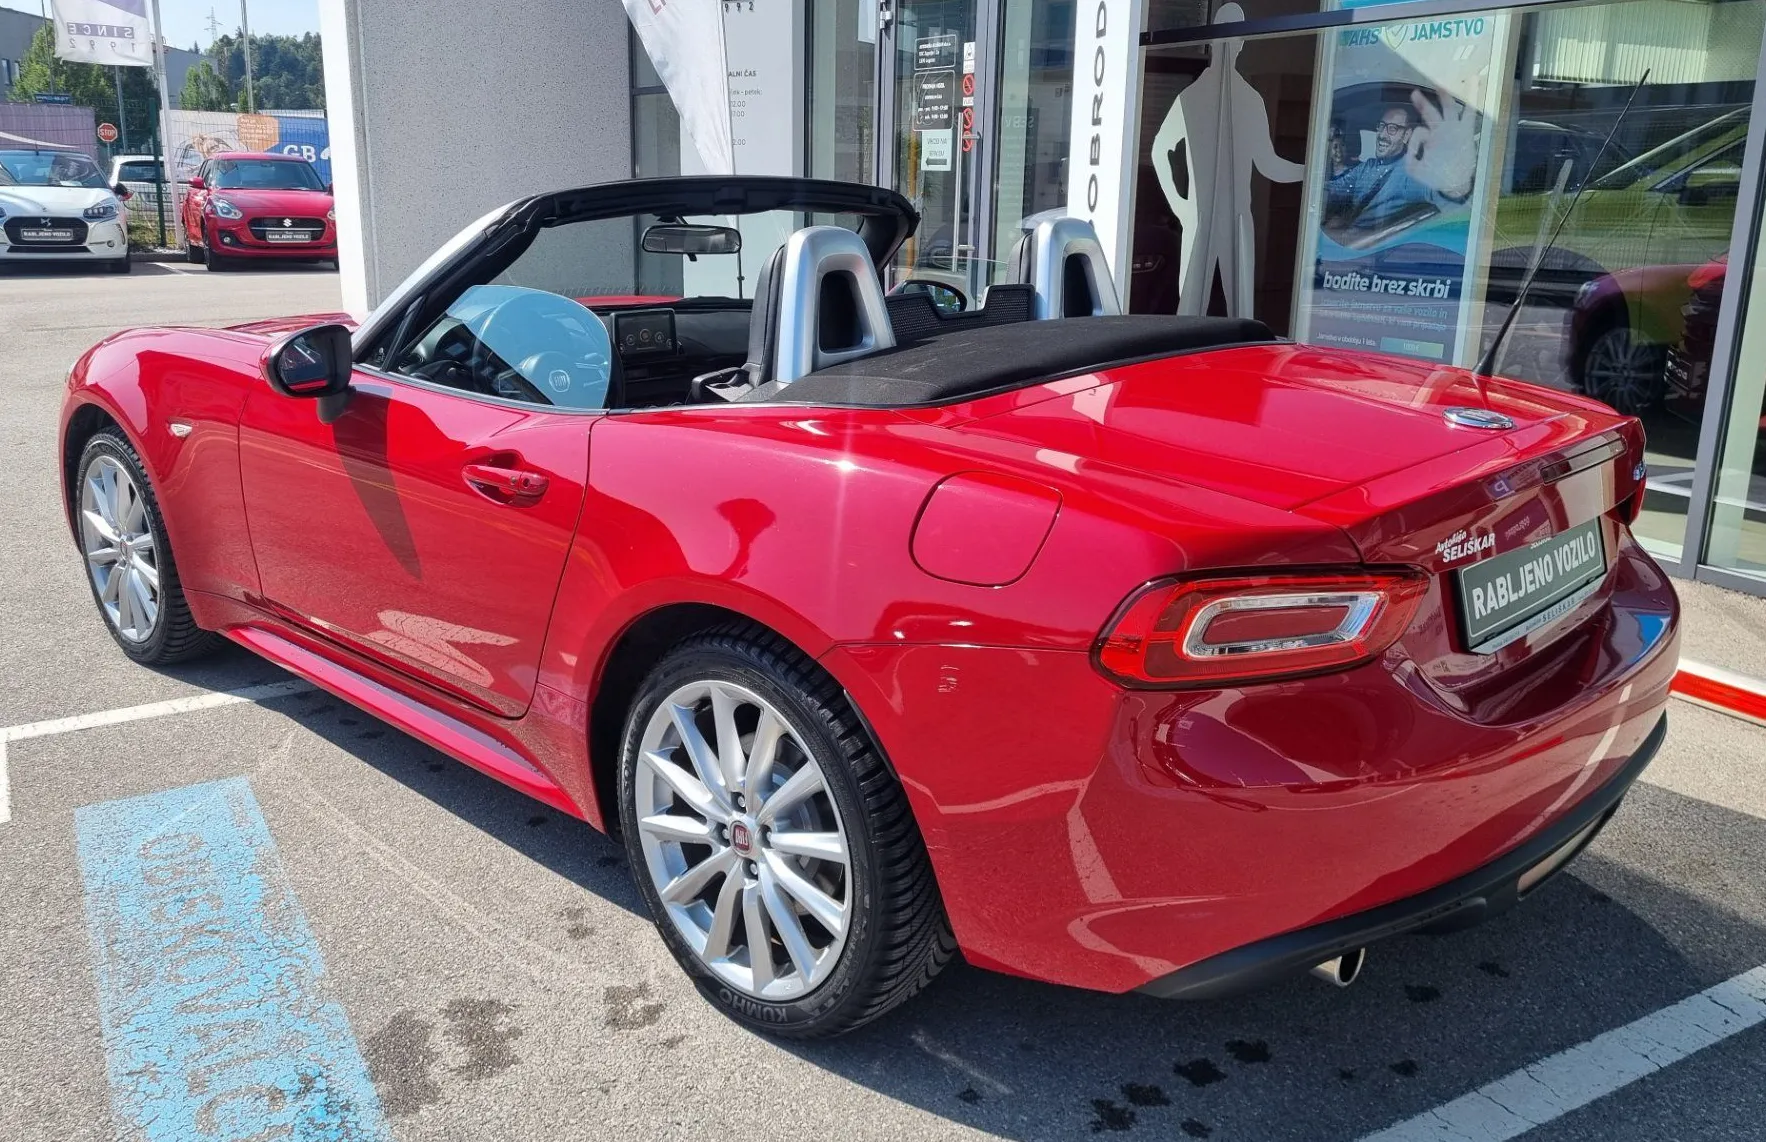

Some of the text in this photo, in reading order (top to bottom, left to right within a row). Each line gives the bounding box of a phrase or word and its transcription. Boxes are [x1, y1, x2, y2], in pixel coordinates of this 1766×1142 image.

[1409, 18, 1485, 42] JAMSTVO
[744, 69, 757, 77] ČAS
[1087, 1, 1107, 232] OBROD
[100, 129, 116, 137] STOP
[283, 144, 317, 163] GB
[1323, 271, 1451, 299] bodite brez skrbi
[1442, 532, 1496, 563] SELIŠKAR
[1471, 530, 1596, 620] RABLJENO VOZILO
[718, 987, 790, 1023] KUMHO
